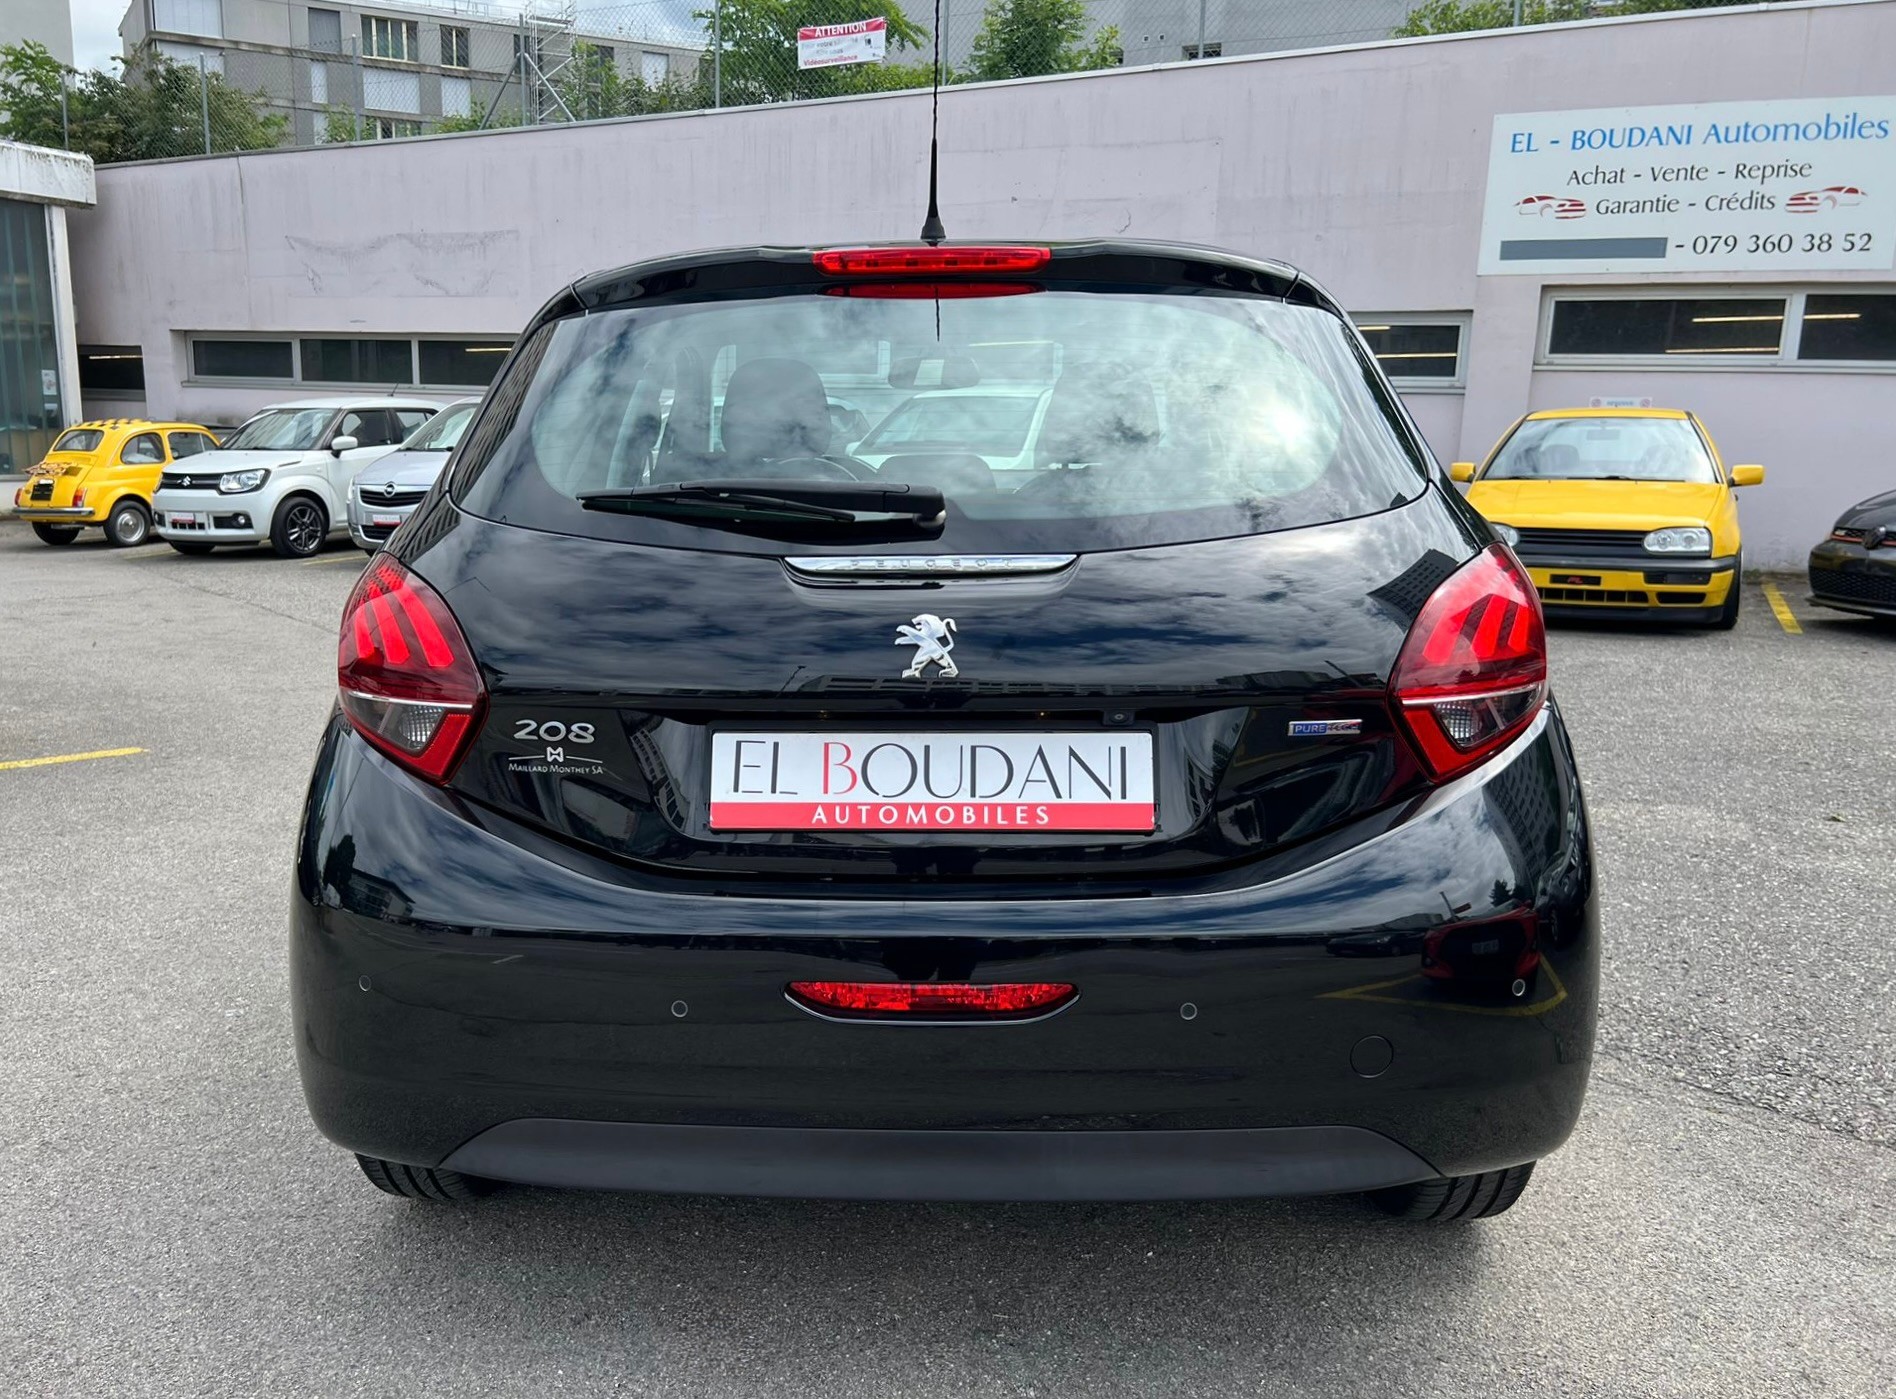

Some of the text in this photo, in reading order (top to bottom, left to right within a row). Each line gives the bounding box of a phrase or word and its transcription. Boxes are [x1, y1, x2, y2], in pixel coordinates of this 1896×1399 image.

[815, 22, 866, 37] ATTENTION
[1510, 132, 1539, 153] EL
[1571, 124, 1693, 152] BOUDANI
[1702, 112, 1889, 145] Automobiles
[1567, 165, 1626, 186] Achat
[1649, 163, 1709, 183] Vente
[1734, 159, 1813, 185] Reprise
[1595, 194, 1680, 215] Garantie
[1705, 191, 1776, 212] Crédits
[1692, 234, 1738, 255] 079
[1746, 234, 1793, 254] 360
[1801, 233, 1832, 253] 38
[1842, 232, 1873, 252] 52
[513, 719, 595, 744] 208
[592, 765, 603, 774] SA
[732, 740, 1128, 801] EL BOUDANI
[811, 805, 1050, 826] AUTOMOBILES
